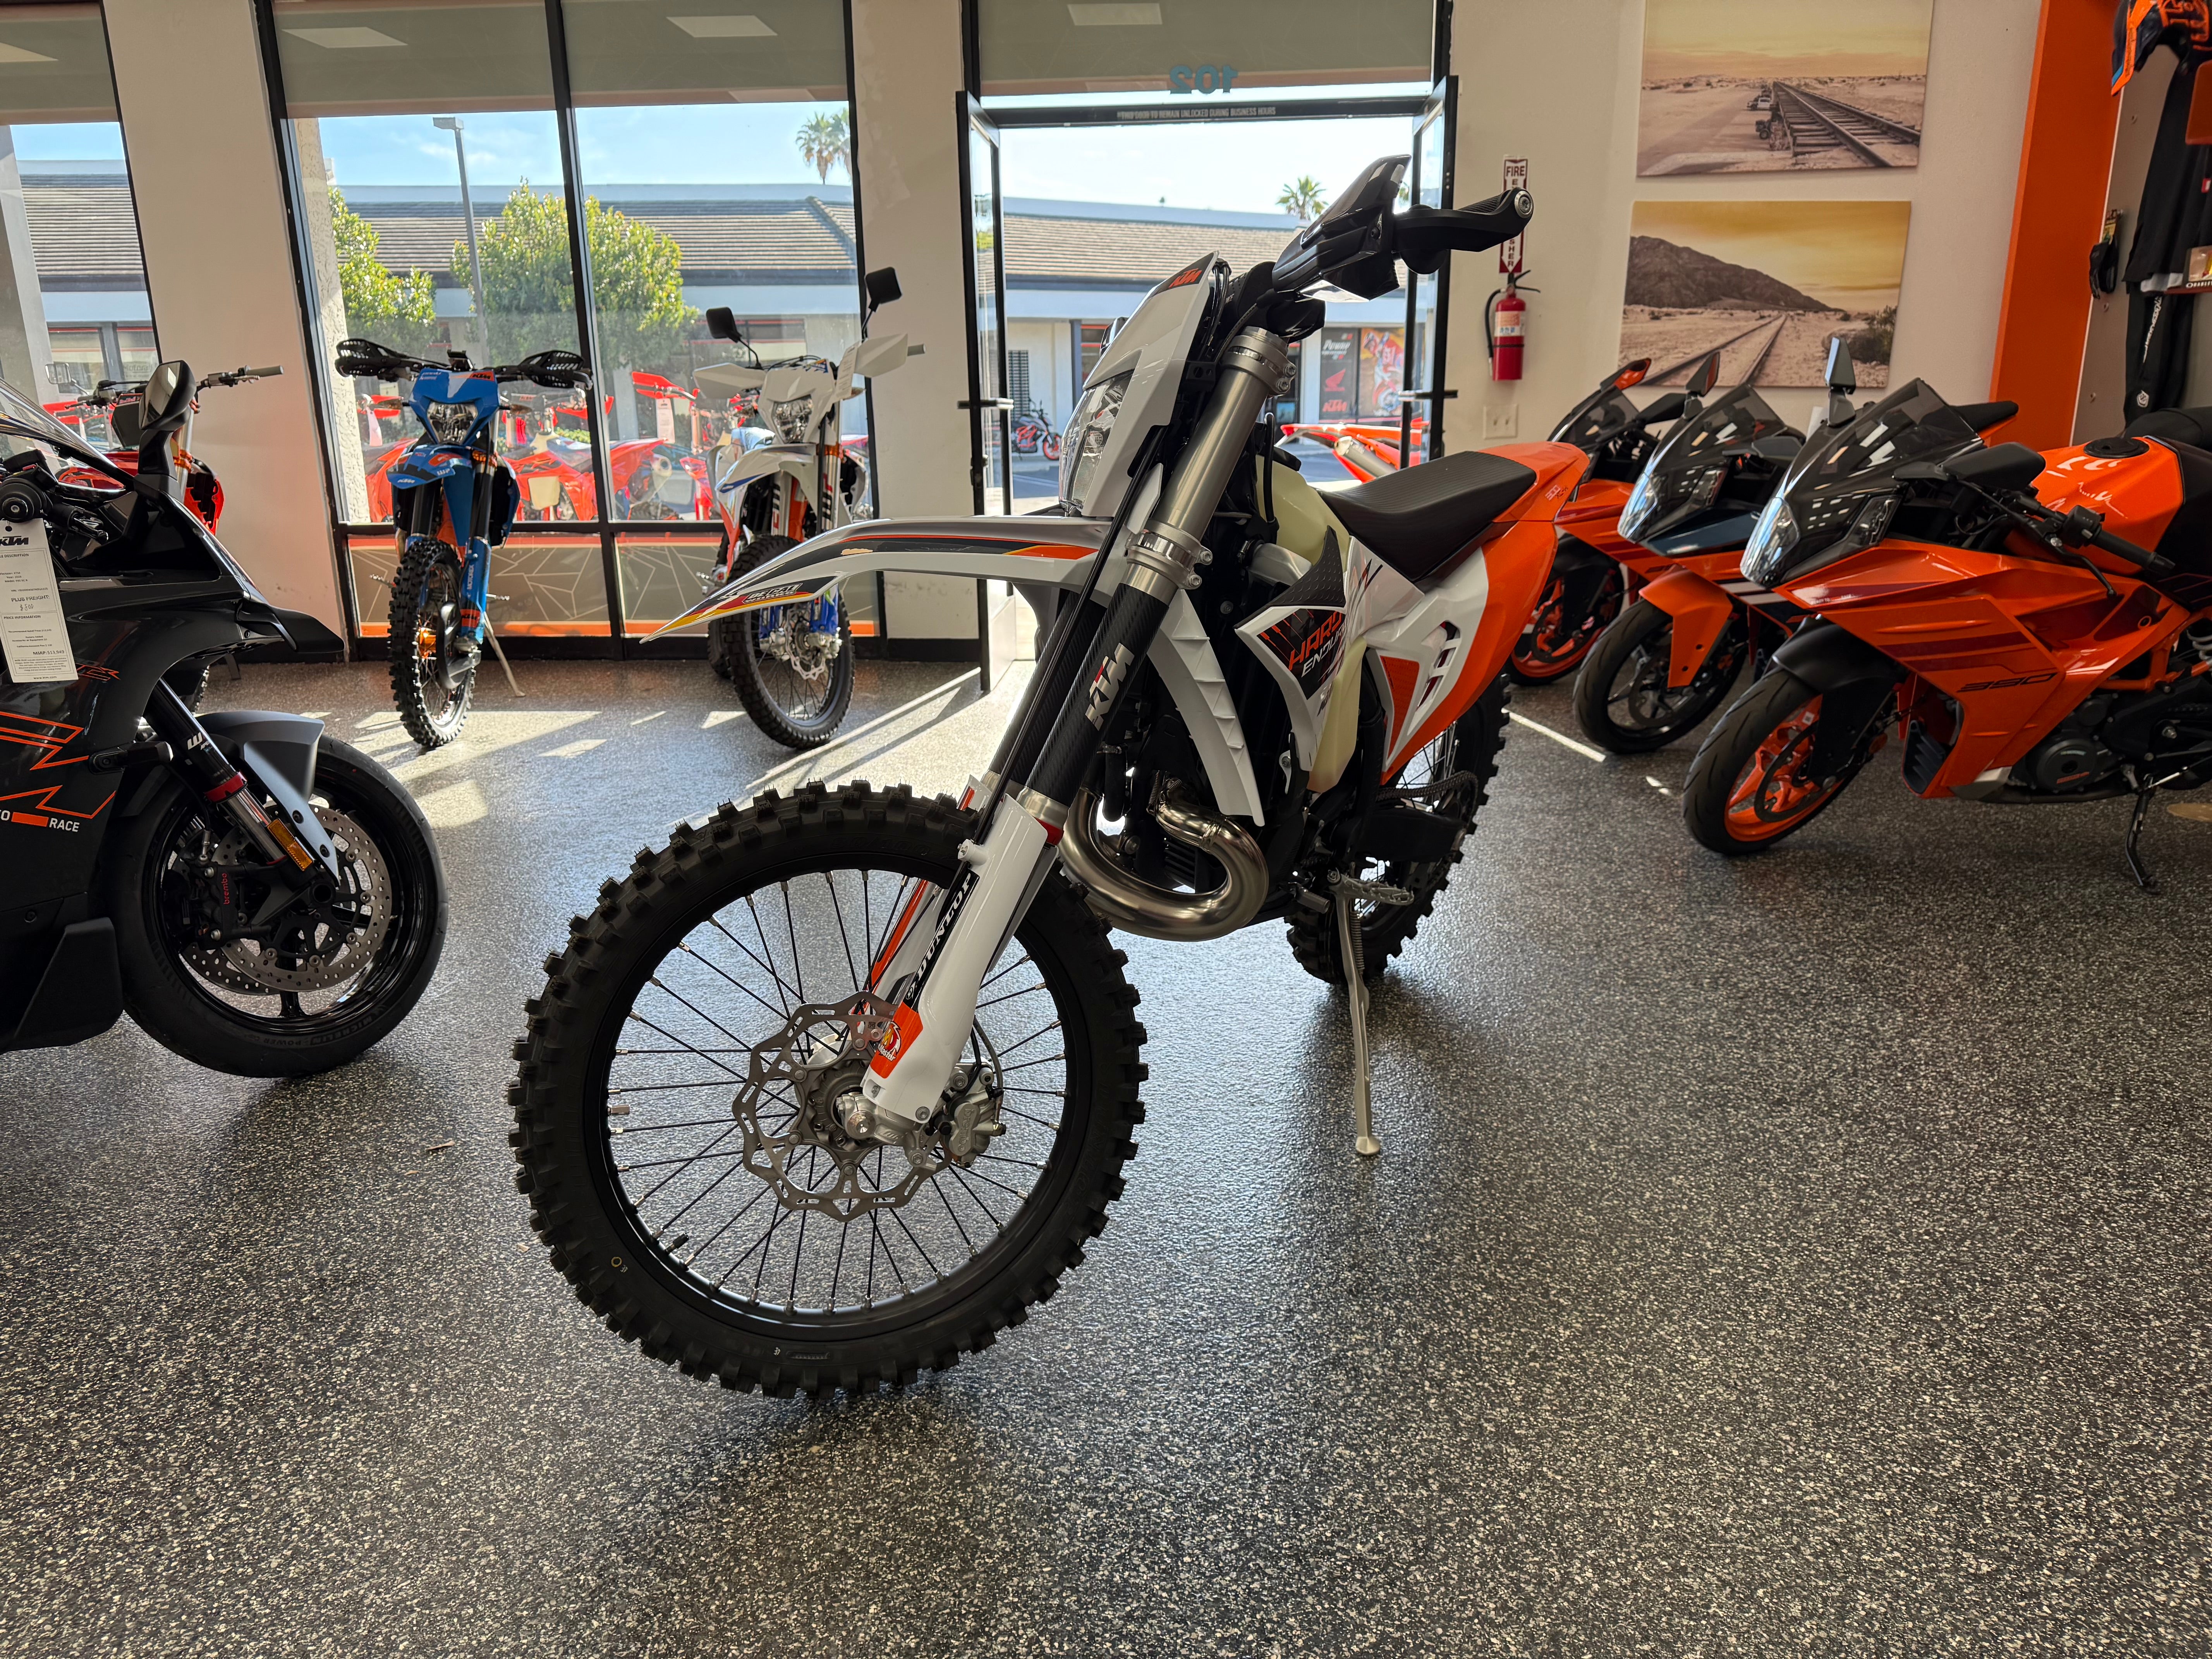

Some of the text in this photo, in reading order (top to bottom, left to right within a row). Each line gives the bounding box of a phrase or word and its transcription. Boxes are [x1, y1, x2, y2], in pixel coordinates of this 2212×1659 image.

[1181, 109, 1208, 118] UNLOCKED
[1209, 108, 1229, 117] DURING
[1230, 107, 1257, 116] BUSINESS
[1258, 106, 1276, 115] HOURS
[1506, 166, 1525, 177] FIRE
[1168, 268, 1202, 288] KTM
[1322, 399, 1348, 413] KTM
[0, 536, 29, 546] KTM
[1289, 611, 1343, 671] HARD
[1301, 623, 1345, 678] ENDUR
[1085, 642, 1135, 731] KTM
[0, 809, 80, 832] O RACE
[221, 873, 230, 905] brembo
[917, 872, 971, 981] DUNLOP
[263, 1037, 302, 1046] POWER
[311, 1015, 373, 1046] MICHELIN
[958, 1108, 975, 1152] brembo
